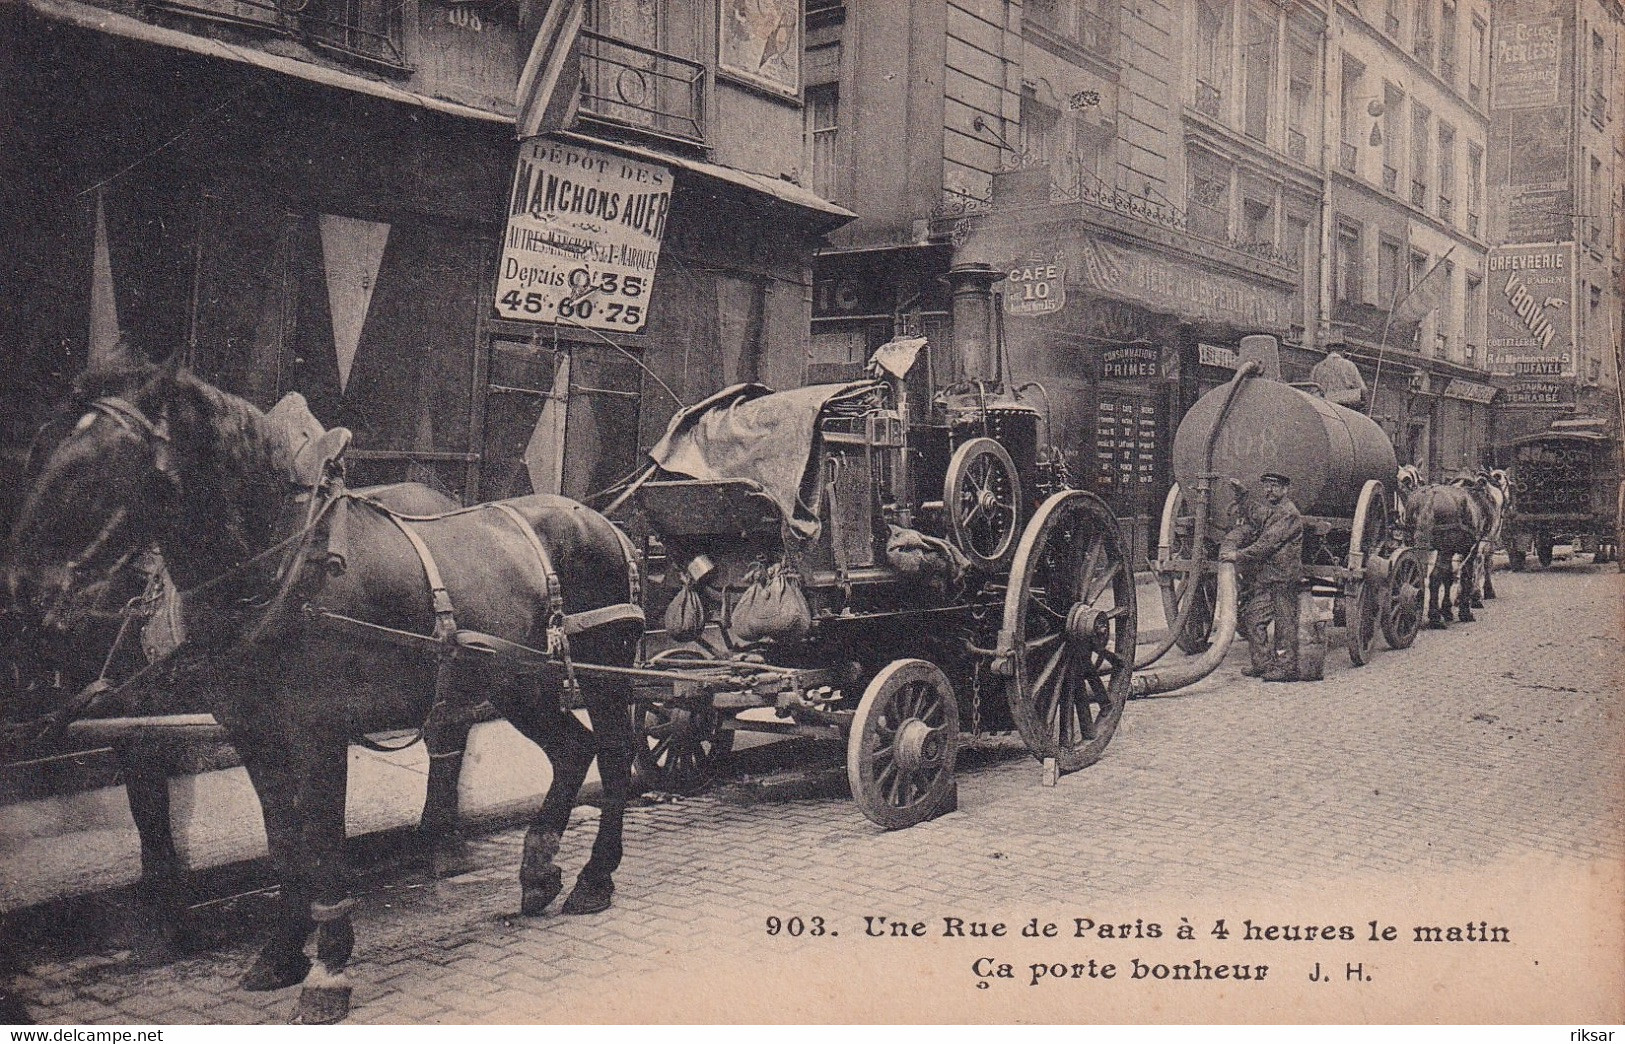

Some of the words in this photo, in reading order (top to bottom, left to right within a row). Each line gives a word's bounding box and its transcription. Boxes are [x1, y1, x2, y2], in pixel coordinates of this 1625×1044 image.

[621, 160, 663, 186] DES
[511, 158, 620, 221] MANCHONS
[621, 192, 671, 242] AUER
[507, 225, 547, 253] AUTRES
[619, 243, 658, 271] MARQUES
[1489, 254, 1564, 271] ORFEVRERIE
[506, 258, 565, 288] Depuis
[1009, 265, 1057, 282] CAFE
[1104, 348, 1157, 362] CONSOMMATIONS
[1104, 363, 1157, 377] PRIMES
[1516, 363, 1561, 375] DUFAYEL
